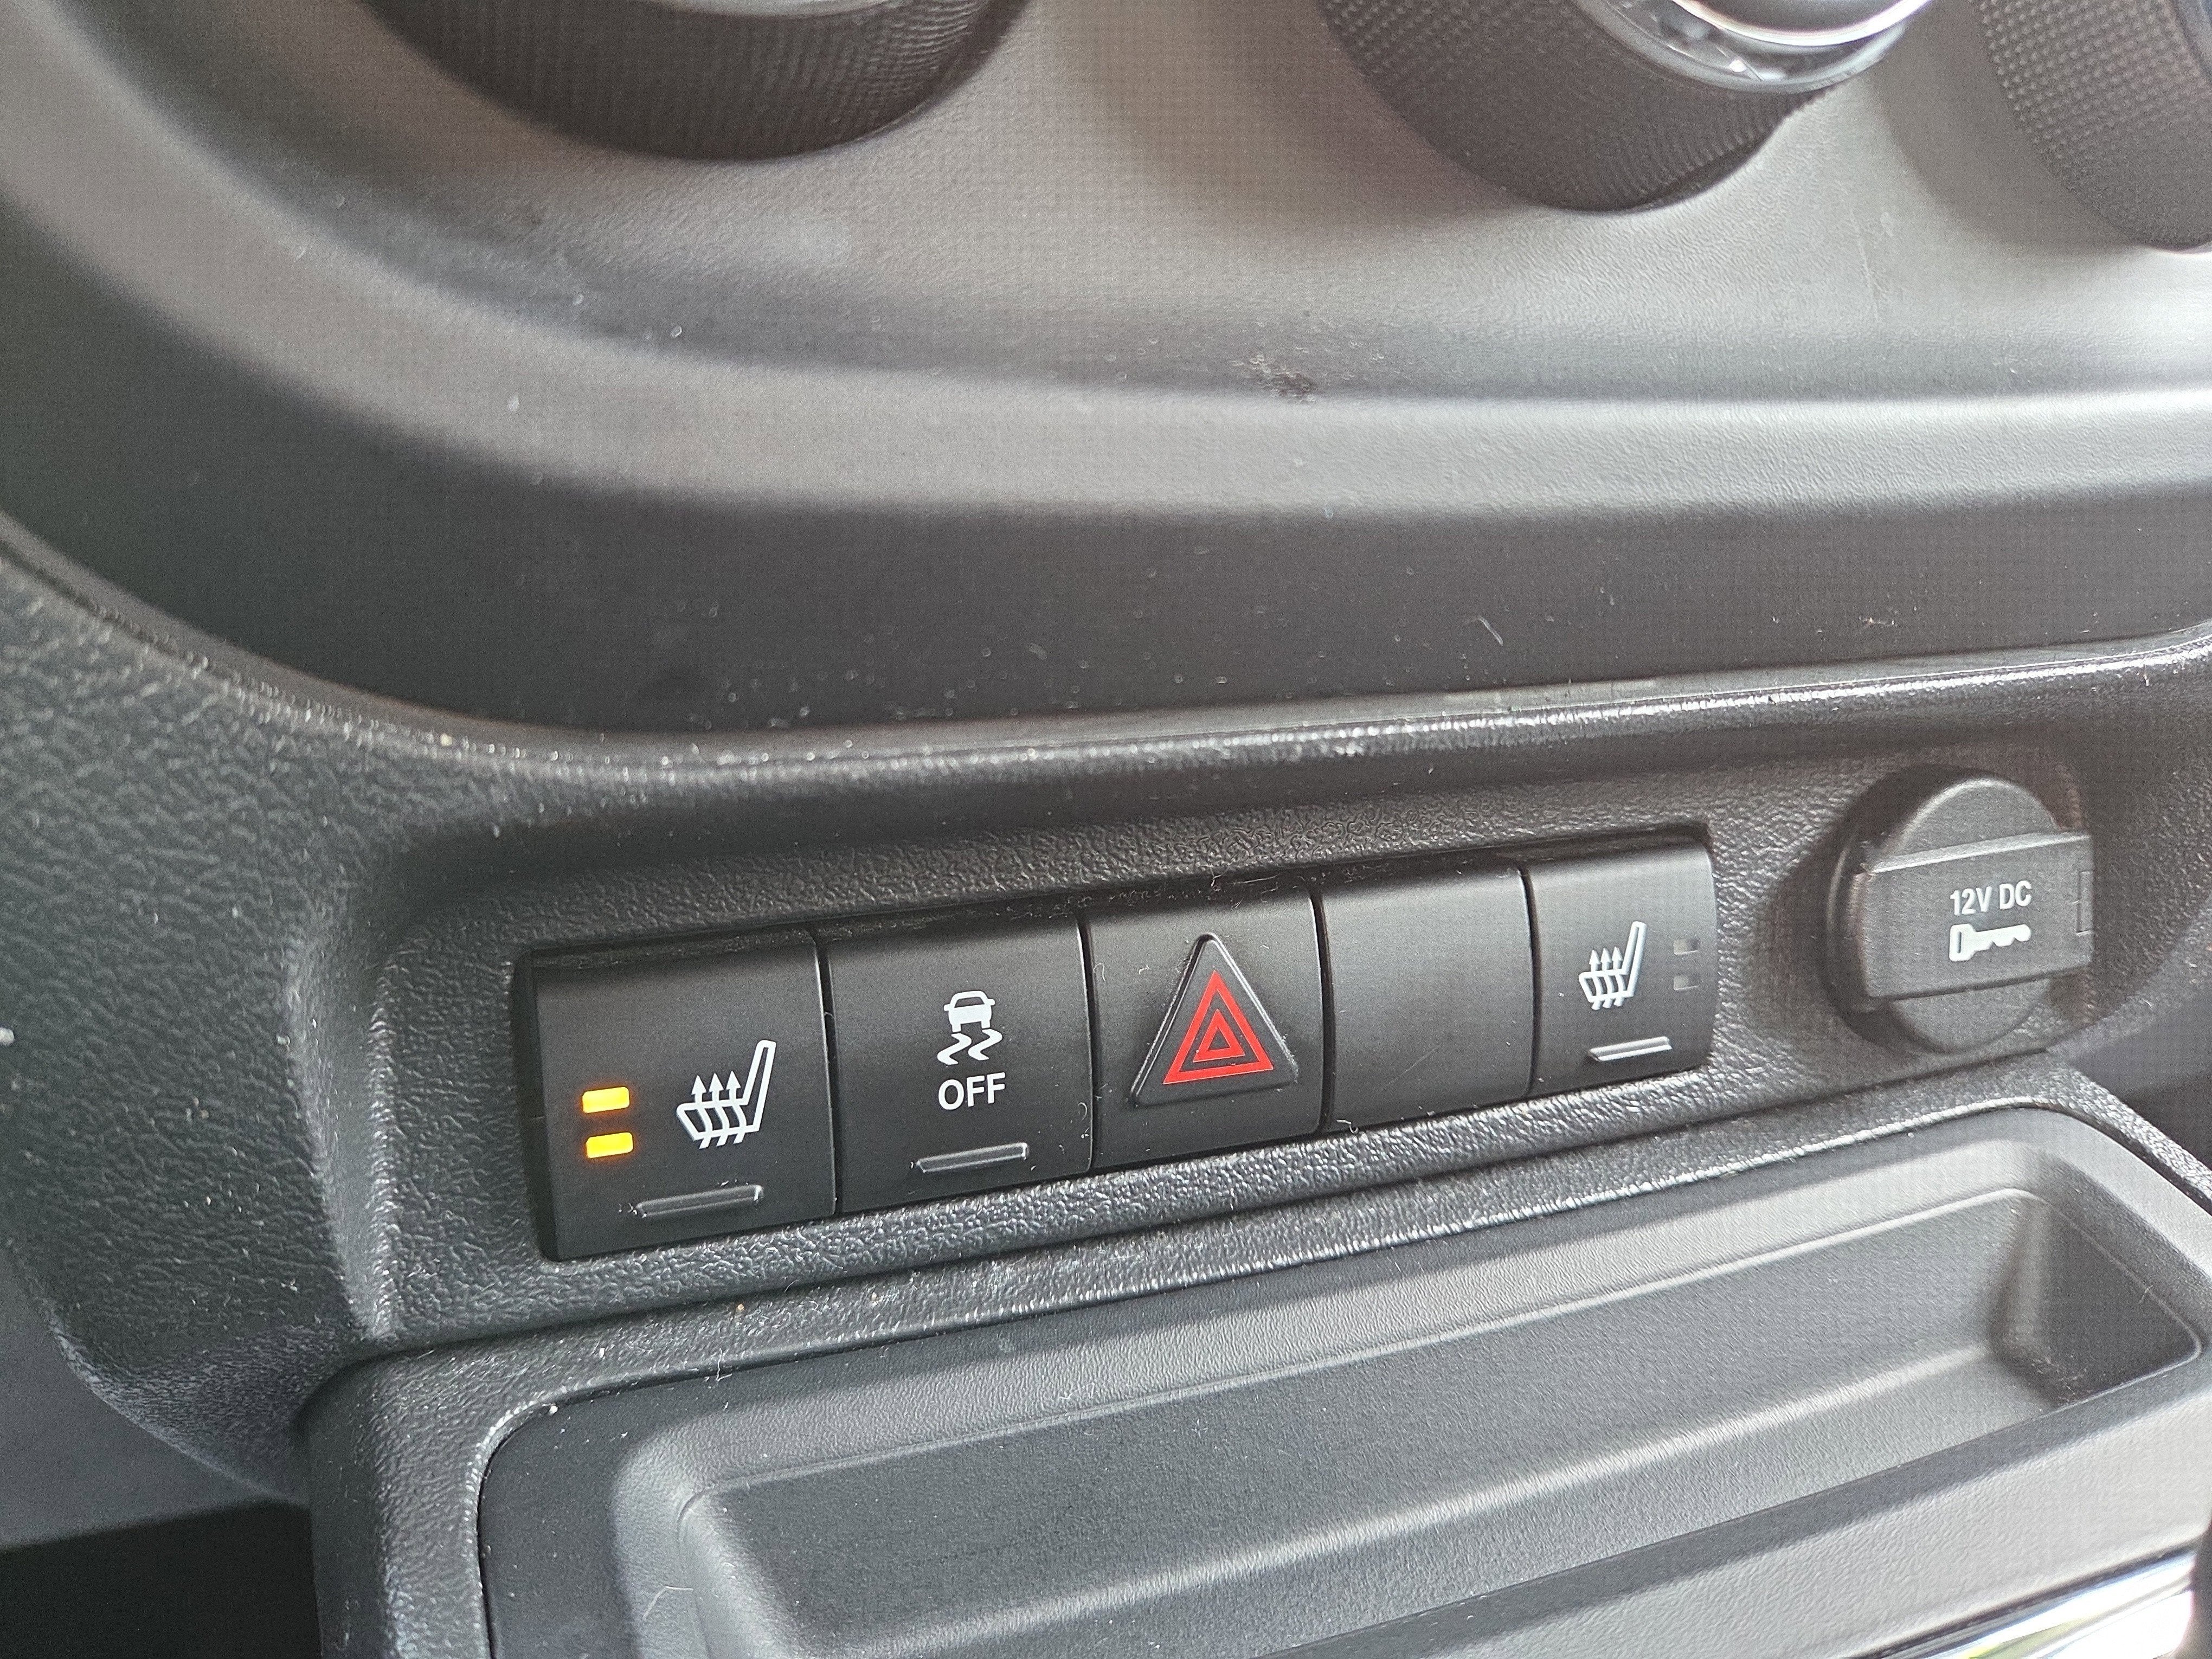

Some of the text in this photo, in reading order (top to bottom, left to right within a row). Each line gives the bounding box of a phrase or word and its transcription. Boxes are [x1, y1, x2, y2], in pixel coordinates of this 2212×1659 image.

[1950, 880, 2032, 916] 12V DC
[938, 1072, 1006, 1110] OFF
